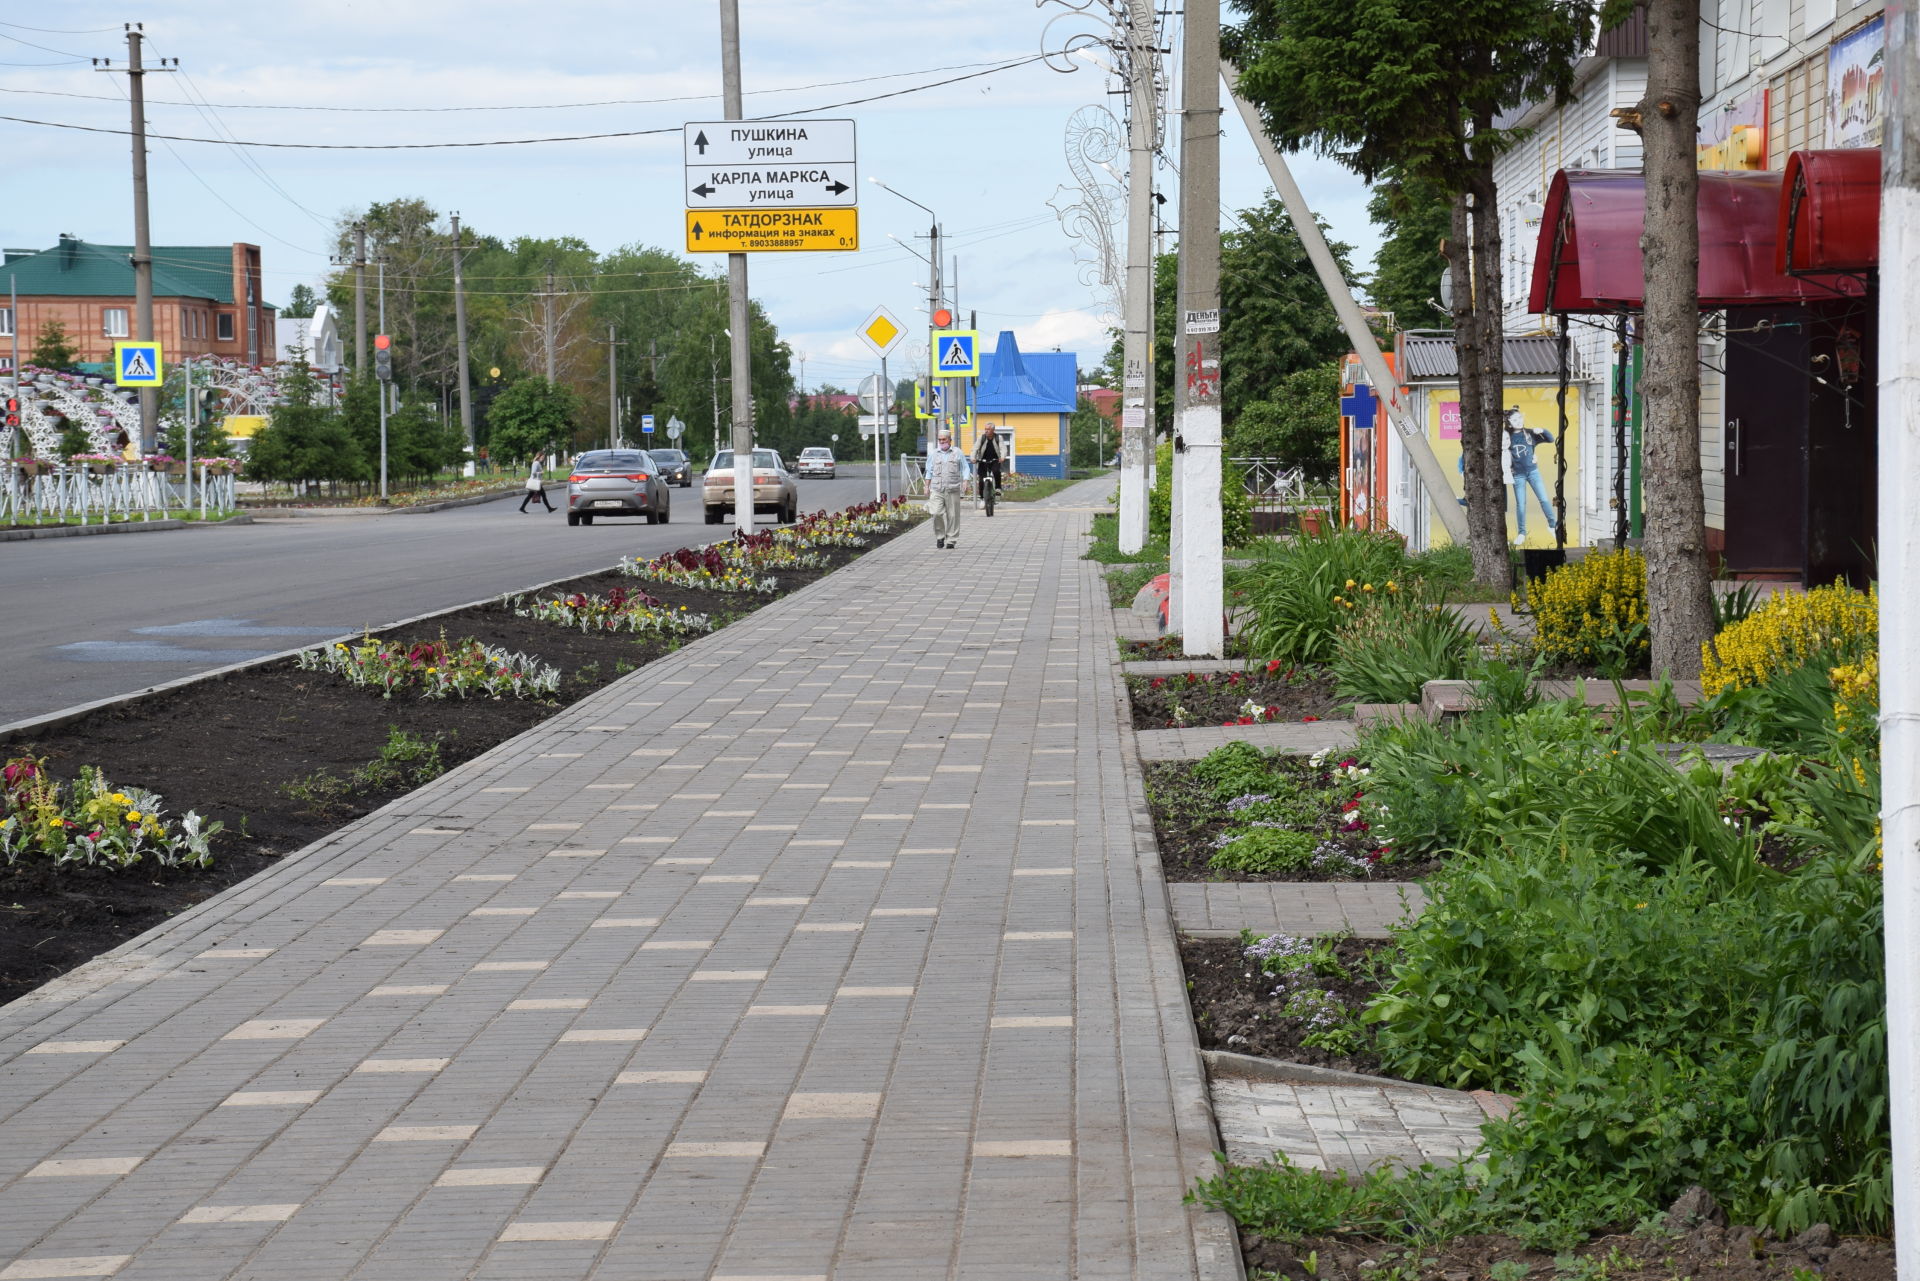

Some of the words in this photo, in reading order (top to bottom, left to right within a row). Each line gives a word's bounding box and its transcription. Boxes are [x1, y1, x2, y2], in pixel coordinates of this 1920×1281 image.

[731, 128, 808, 142] ПУШКИНА
[748, 146, 793, 160] улица
[711, 172, 762, 185] КАРЛА
[766, 170, 830, 184] МАРКСА
[749, 188, 794, 202] улица
[722, 213, 823, 228] ТАТДОРЗНАК
[708, 229, 780, 239] информация
[798, 229, 835, 237] знаках
[839, 237, 854, 247] 0,1
